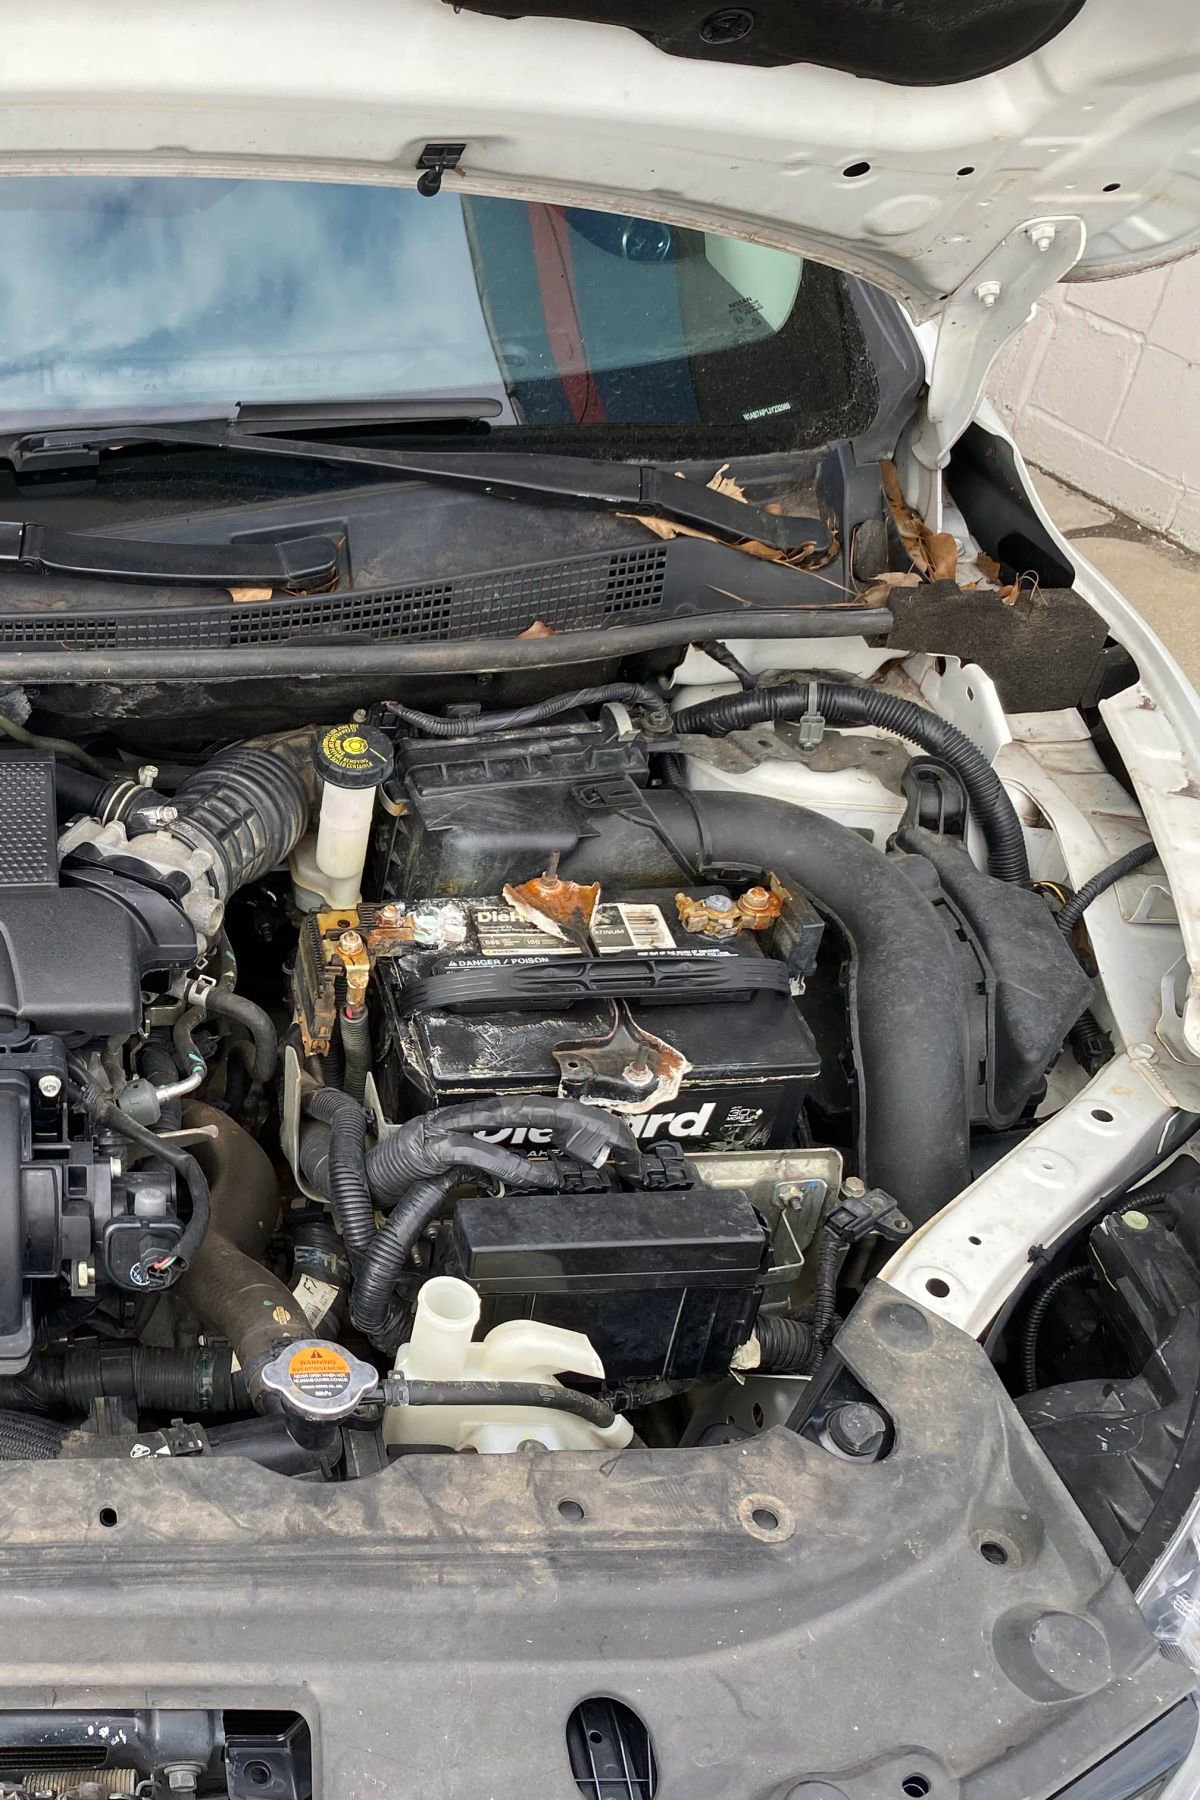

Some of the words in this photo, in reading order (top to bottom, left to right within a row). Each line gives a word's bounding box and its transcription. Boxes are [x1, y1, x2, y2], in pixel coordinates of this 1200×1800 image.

[477, 911, 526, 923] DieH
[458, 959, 501, 967] DANGER
[511, 957, 550, 965] POISON
